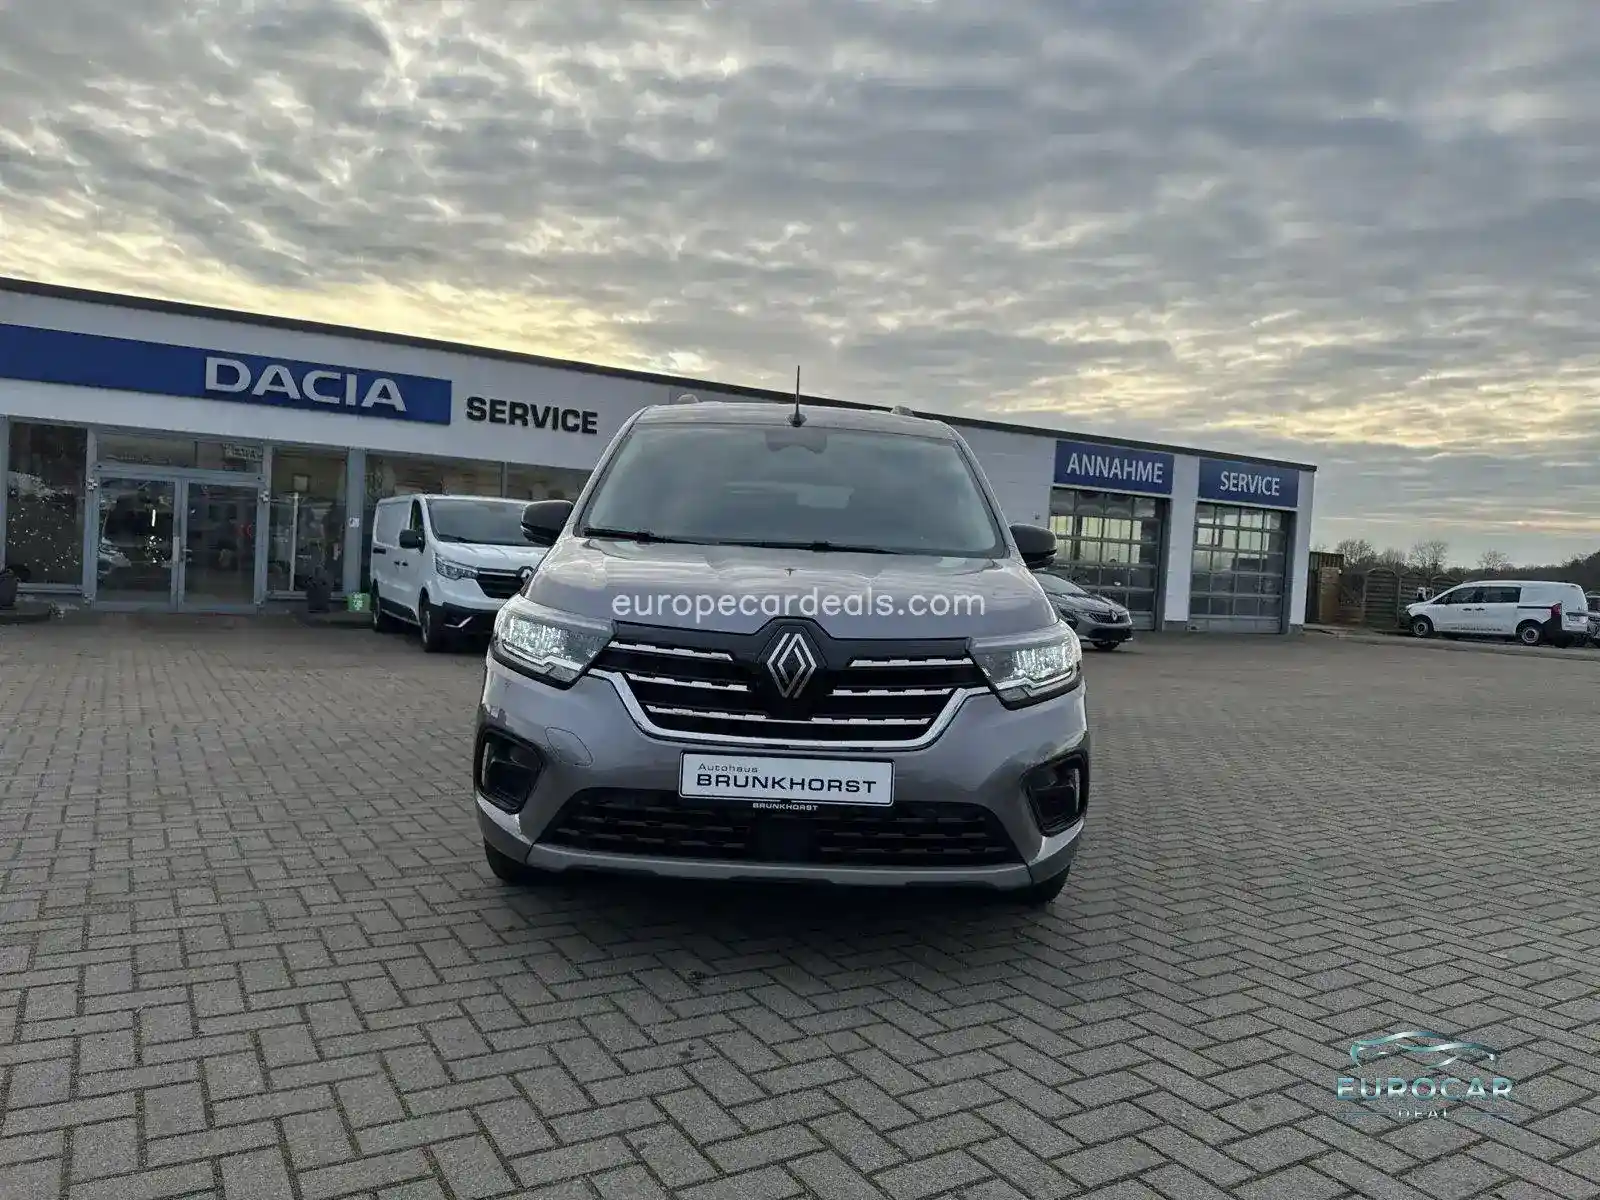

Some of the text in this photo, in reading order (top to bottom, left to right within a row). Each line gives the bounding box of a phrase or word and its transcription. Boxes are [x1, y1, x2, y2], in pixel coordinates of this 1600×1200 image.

[205, 356, 407, 412] DACIA
[466, 396, 598, 434] SERVICE
[1066, 453, 1164, 484] ANNAHME
[1219, 471, 1281, 496] SERVICE
[698, 762, 759, 773] Autohaus
[696, 774, 877, 793] BRUNKHORST
[752, 802, 818, 812] BRUNKHORST
